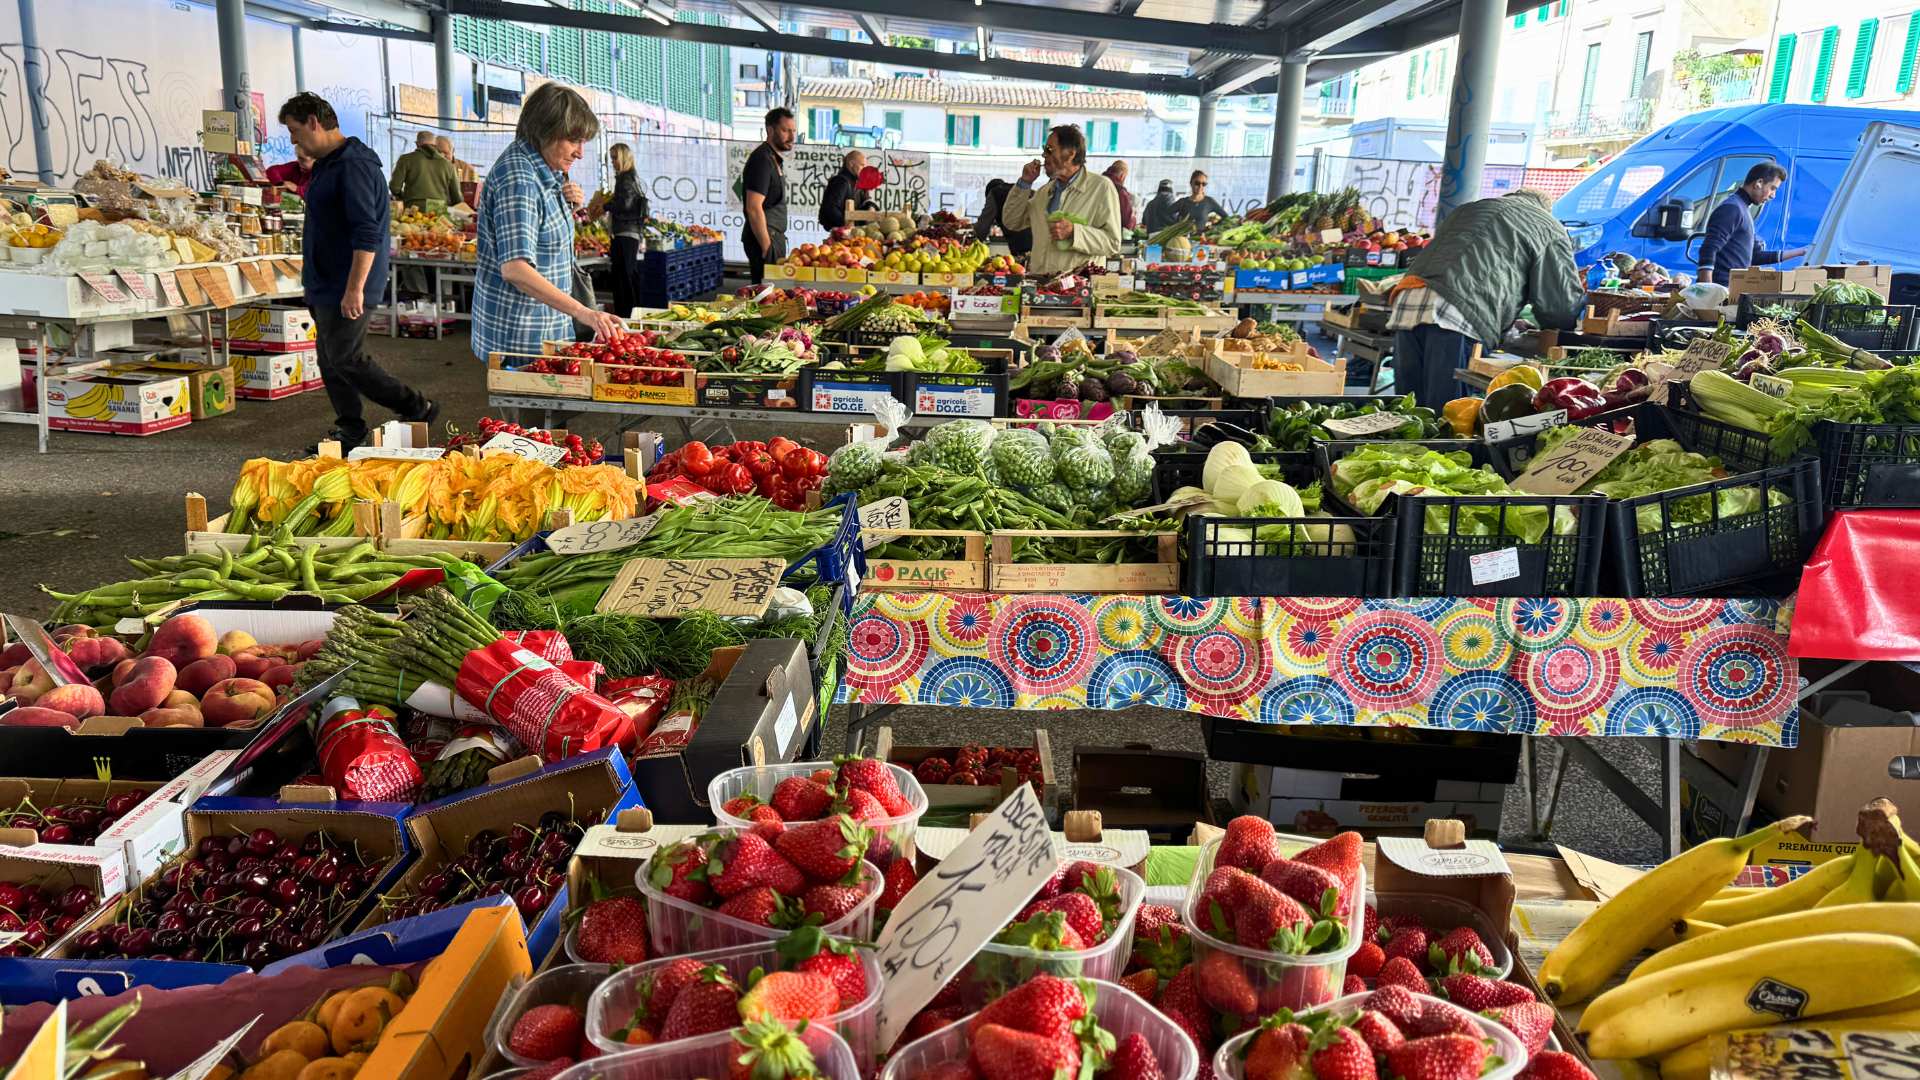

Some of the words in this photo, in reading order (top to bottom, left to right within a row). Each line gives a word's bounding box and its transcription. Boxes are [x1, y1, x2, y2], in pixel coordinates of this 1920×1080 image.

[833, 396, 864, 404] agricola
[936, 398, 967, 406] agricola
[108, 405, 140, 414] BANANAS
[832, 402, 868, 412] DO.GE.
[936, 405, 971, 414] DO.GE.
[1778, 842, 1833, 854] PREMIUM
